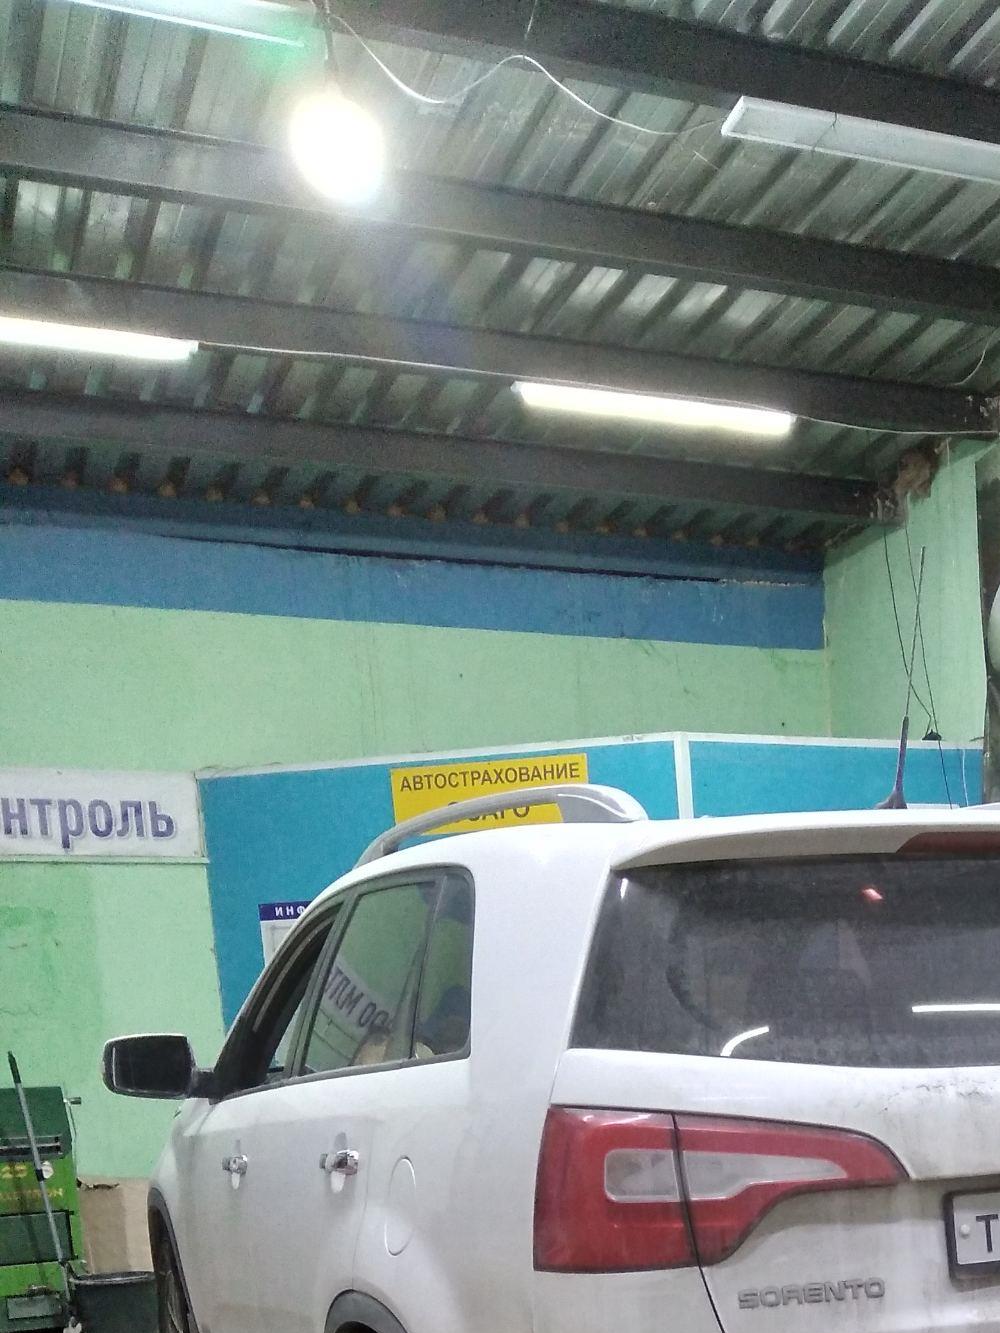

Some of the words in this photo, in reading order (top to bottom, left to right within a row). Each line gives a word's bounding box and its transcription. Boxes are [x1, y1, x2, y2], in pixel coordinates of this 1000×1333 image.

[400, 762, 580, 792] АВТОСТРАХОВАНИЕ
[0, 797, 175, 849] нтроль
[738, 1277, 885, 1309] SORENTO
